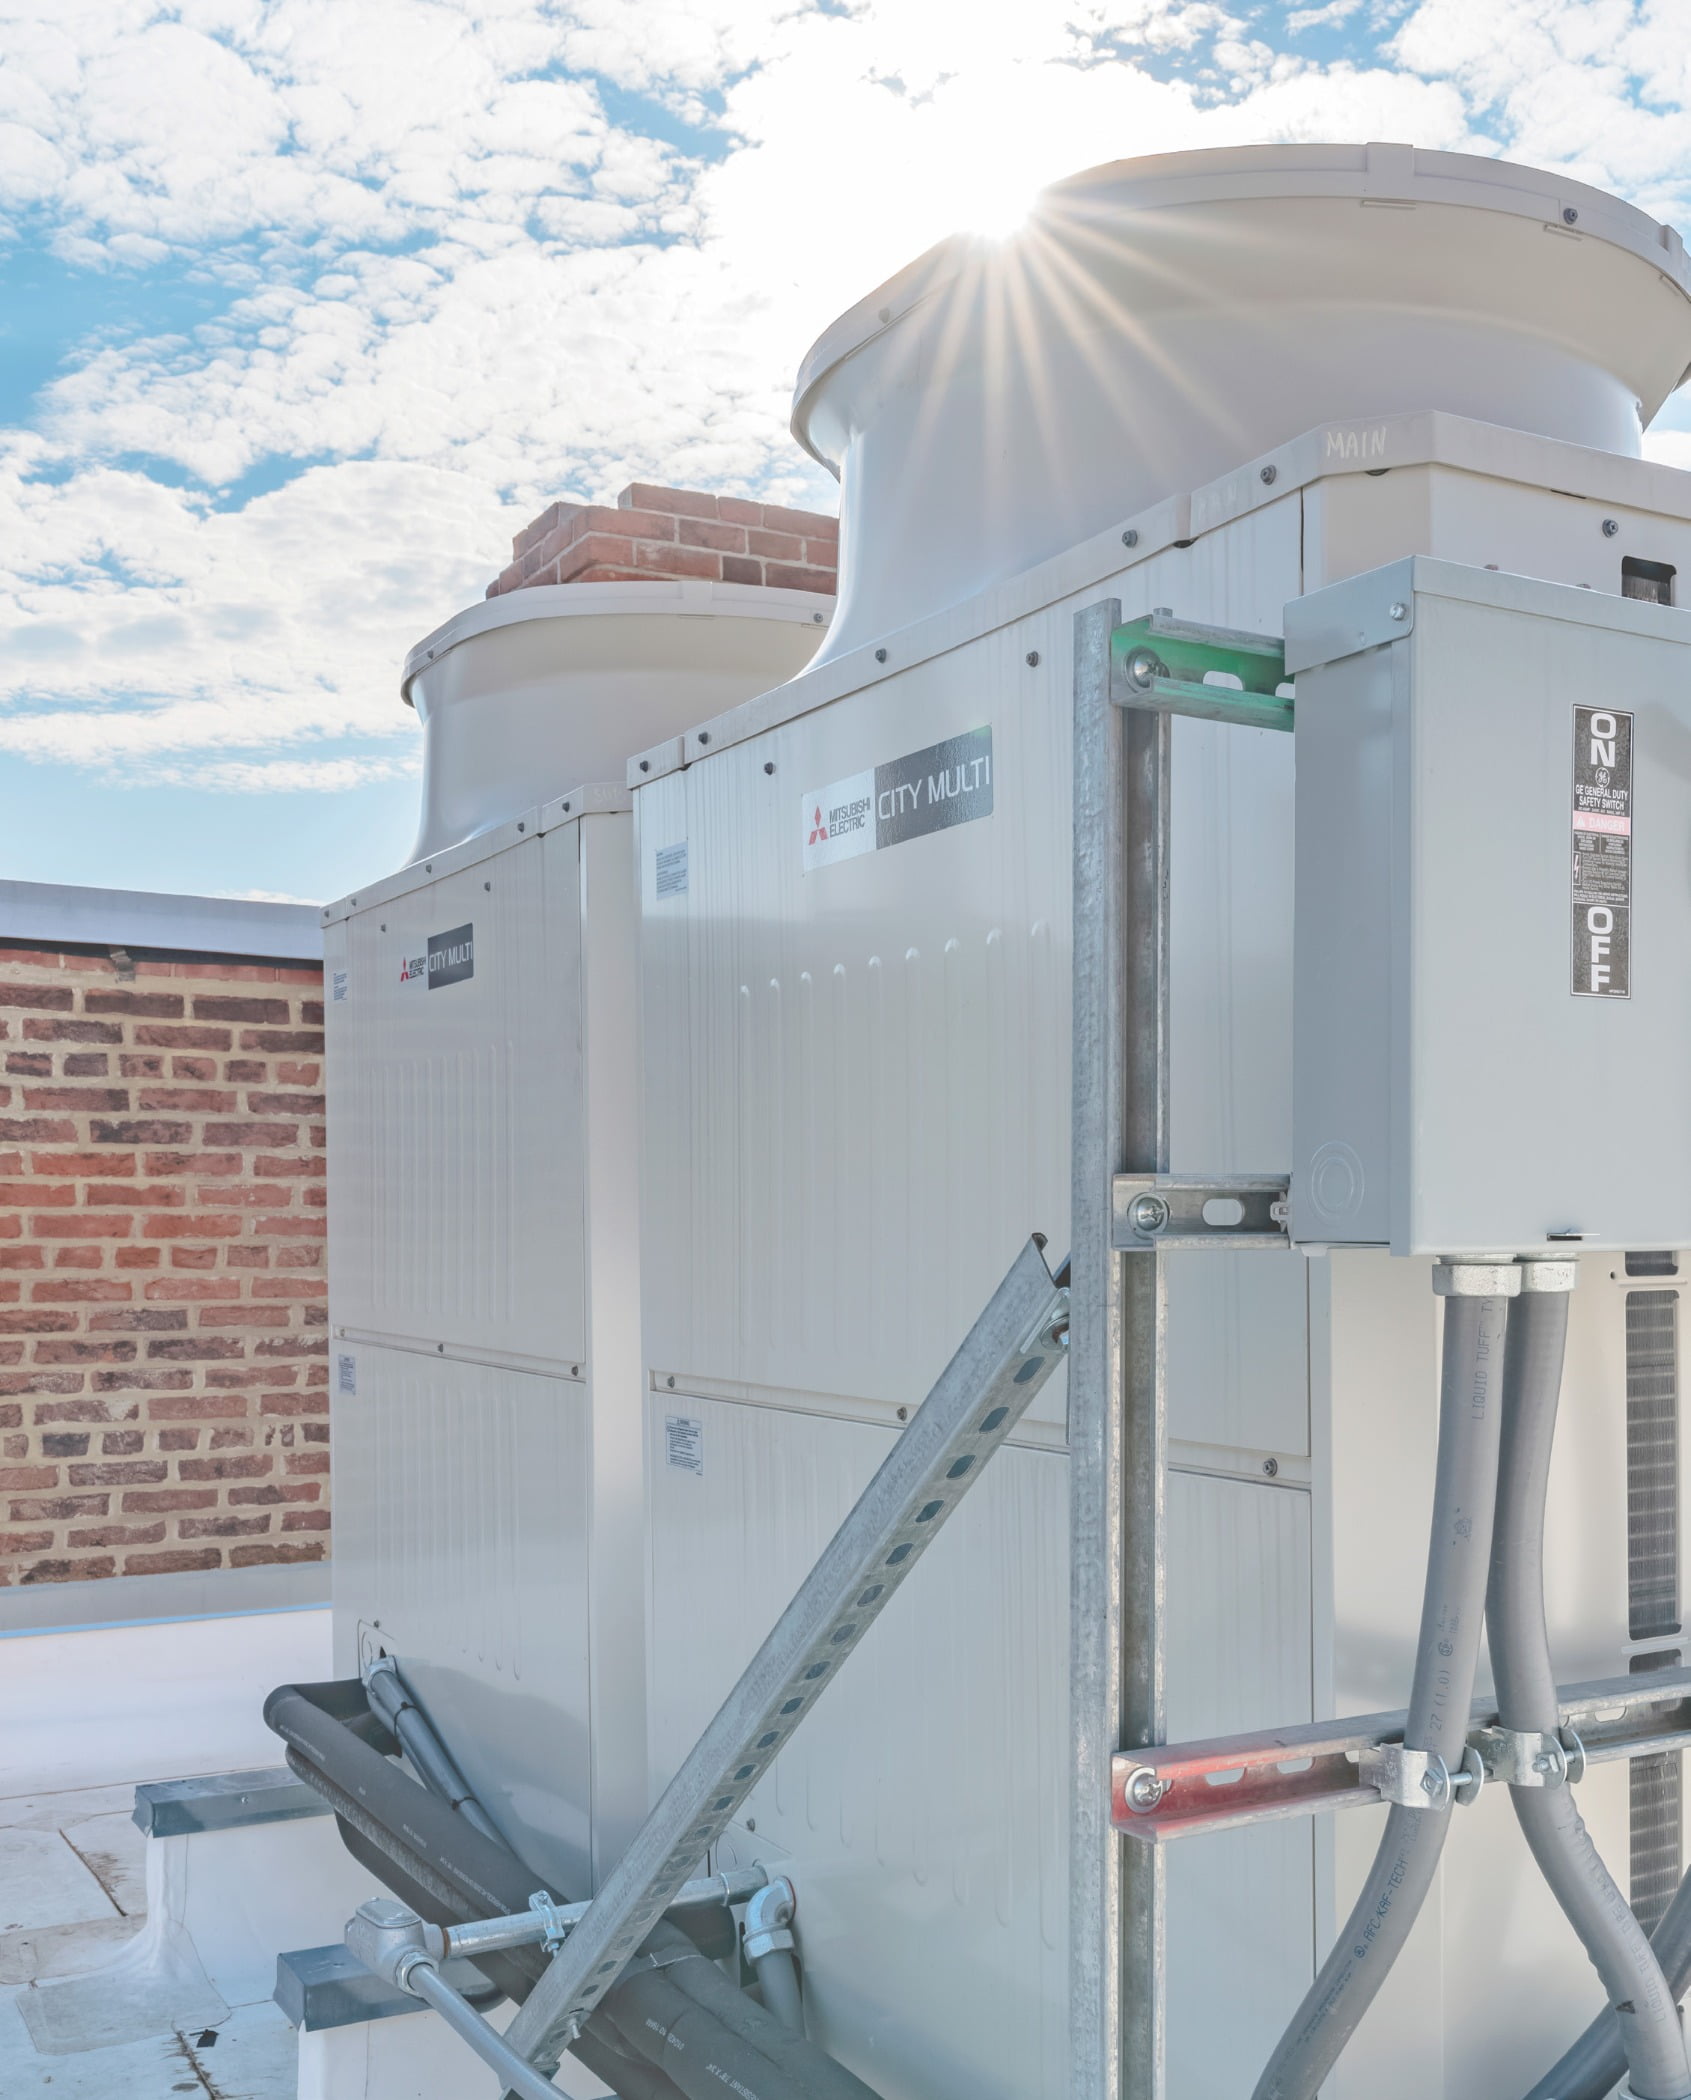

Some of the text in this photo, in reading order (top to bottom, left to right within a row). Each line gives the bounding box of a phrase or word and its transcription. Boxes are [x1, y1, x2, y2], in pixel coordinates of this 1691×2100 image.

[1326, 426, 1387, 459] MAIN
[1589, 711, 1617, 769] ON
[878, 755, 990, 820] CITY MULTI
[1575, 784, 1629, 801] GE GENERAL DUTY
[829, 797, 871, 823] MITSUBISHI
[1579, 796, 1601, 809] SAFETY
[1601, 798, 1625, 811] SWITCH
[829, 815, 865, 838] ELECTRIC
[1589, 816, 1625, 832] DANGER
[429, 949, 448, 973] CITY
[448, 941, 473, 967] MULTI
[1587, 905, 1614, 993] OFF
[1471, 1370, 1488, 1421] LIQUID
[1429, 1713, 1443, 1731] 27
